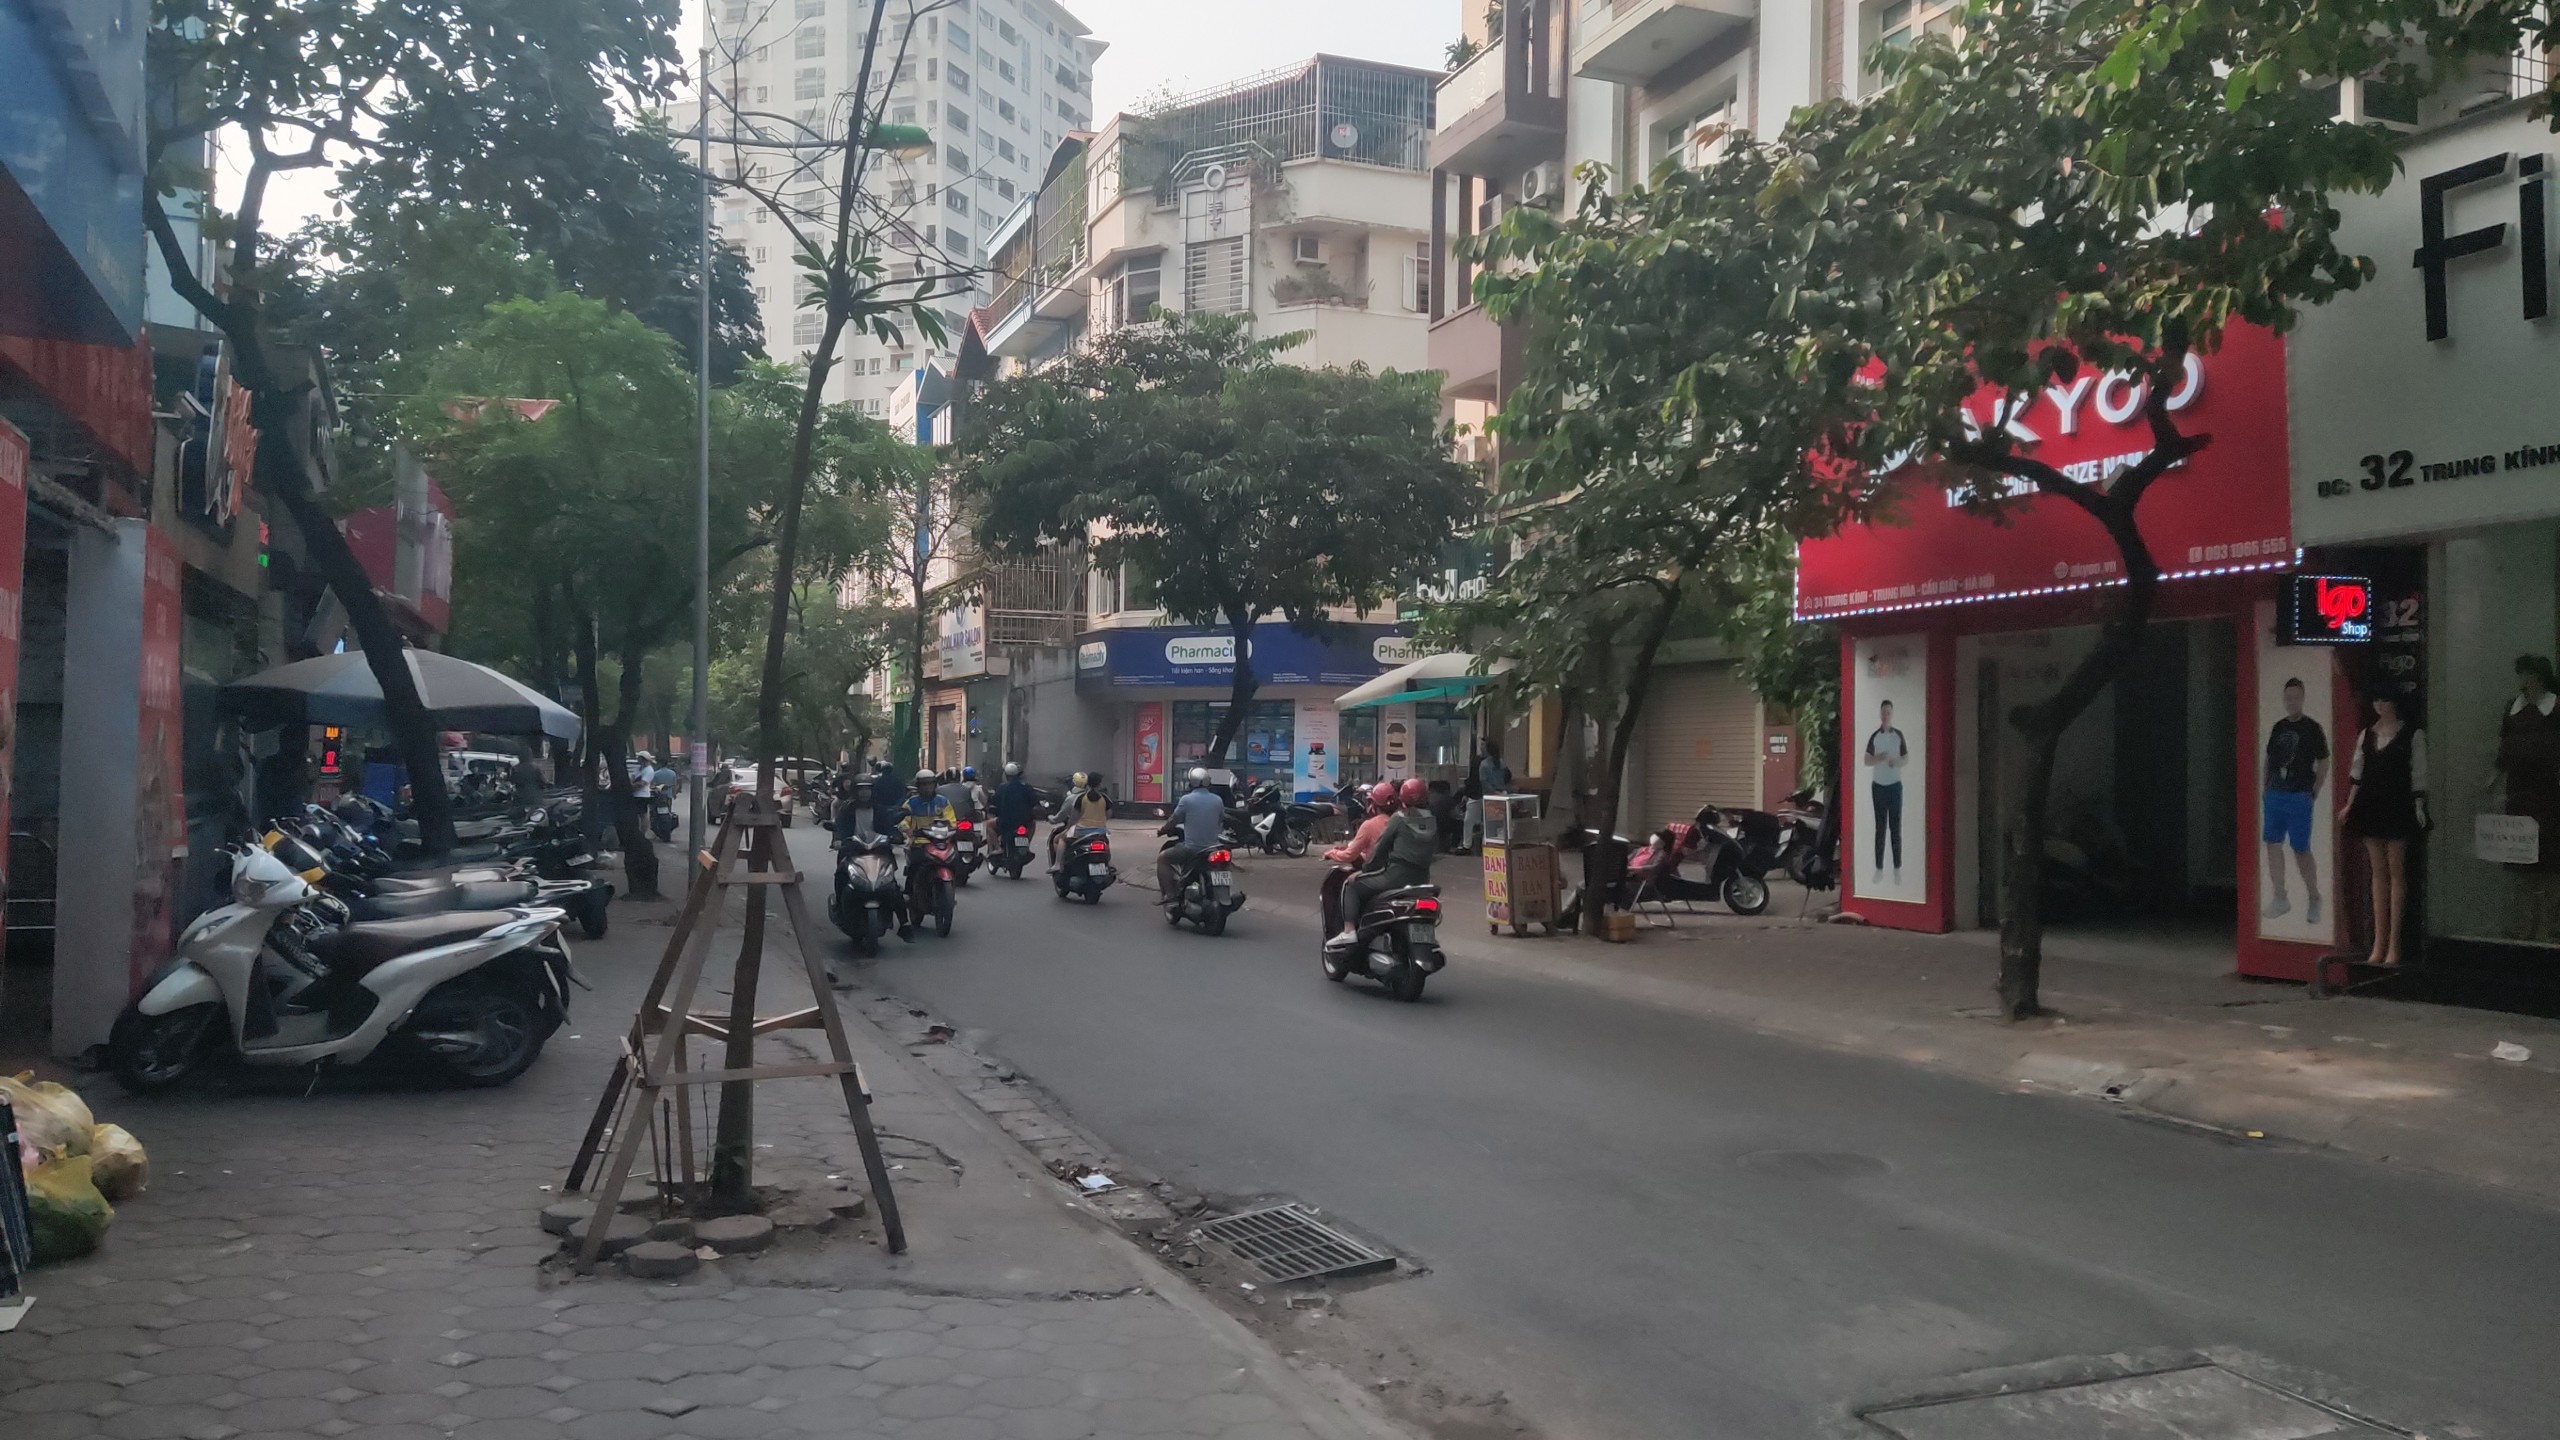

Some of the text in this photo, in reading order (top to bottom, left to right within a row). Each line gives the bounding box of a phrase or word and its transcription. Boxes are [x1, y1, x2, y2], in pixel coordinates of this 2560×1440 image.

[2062, 460, 2099, 484] SIZE
[2359, 449, 2414, 490] 32
[2419, 454, 2496, 482] TRUNG
[2262, 537, 2287, 555] 555
[1824, 594, 1848, 607] TRUNG
[1873, 587, 1898, 602] TRUNG
[2341, 621, 2368, 637] Shop
[1171, 646, 1233, 658] Pharmaci
[1379, 645, 1440, 659] Pharma
